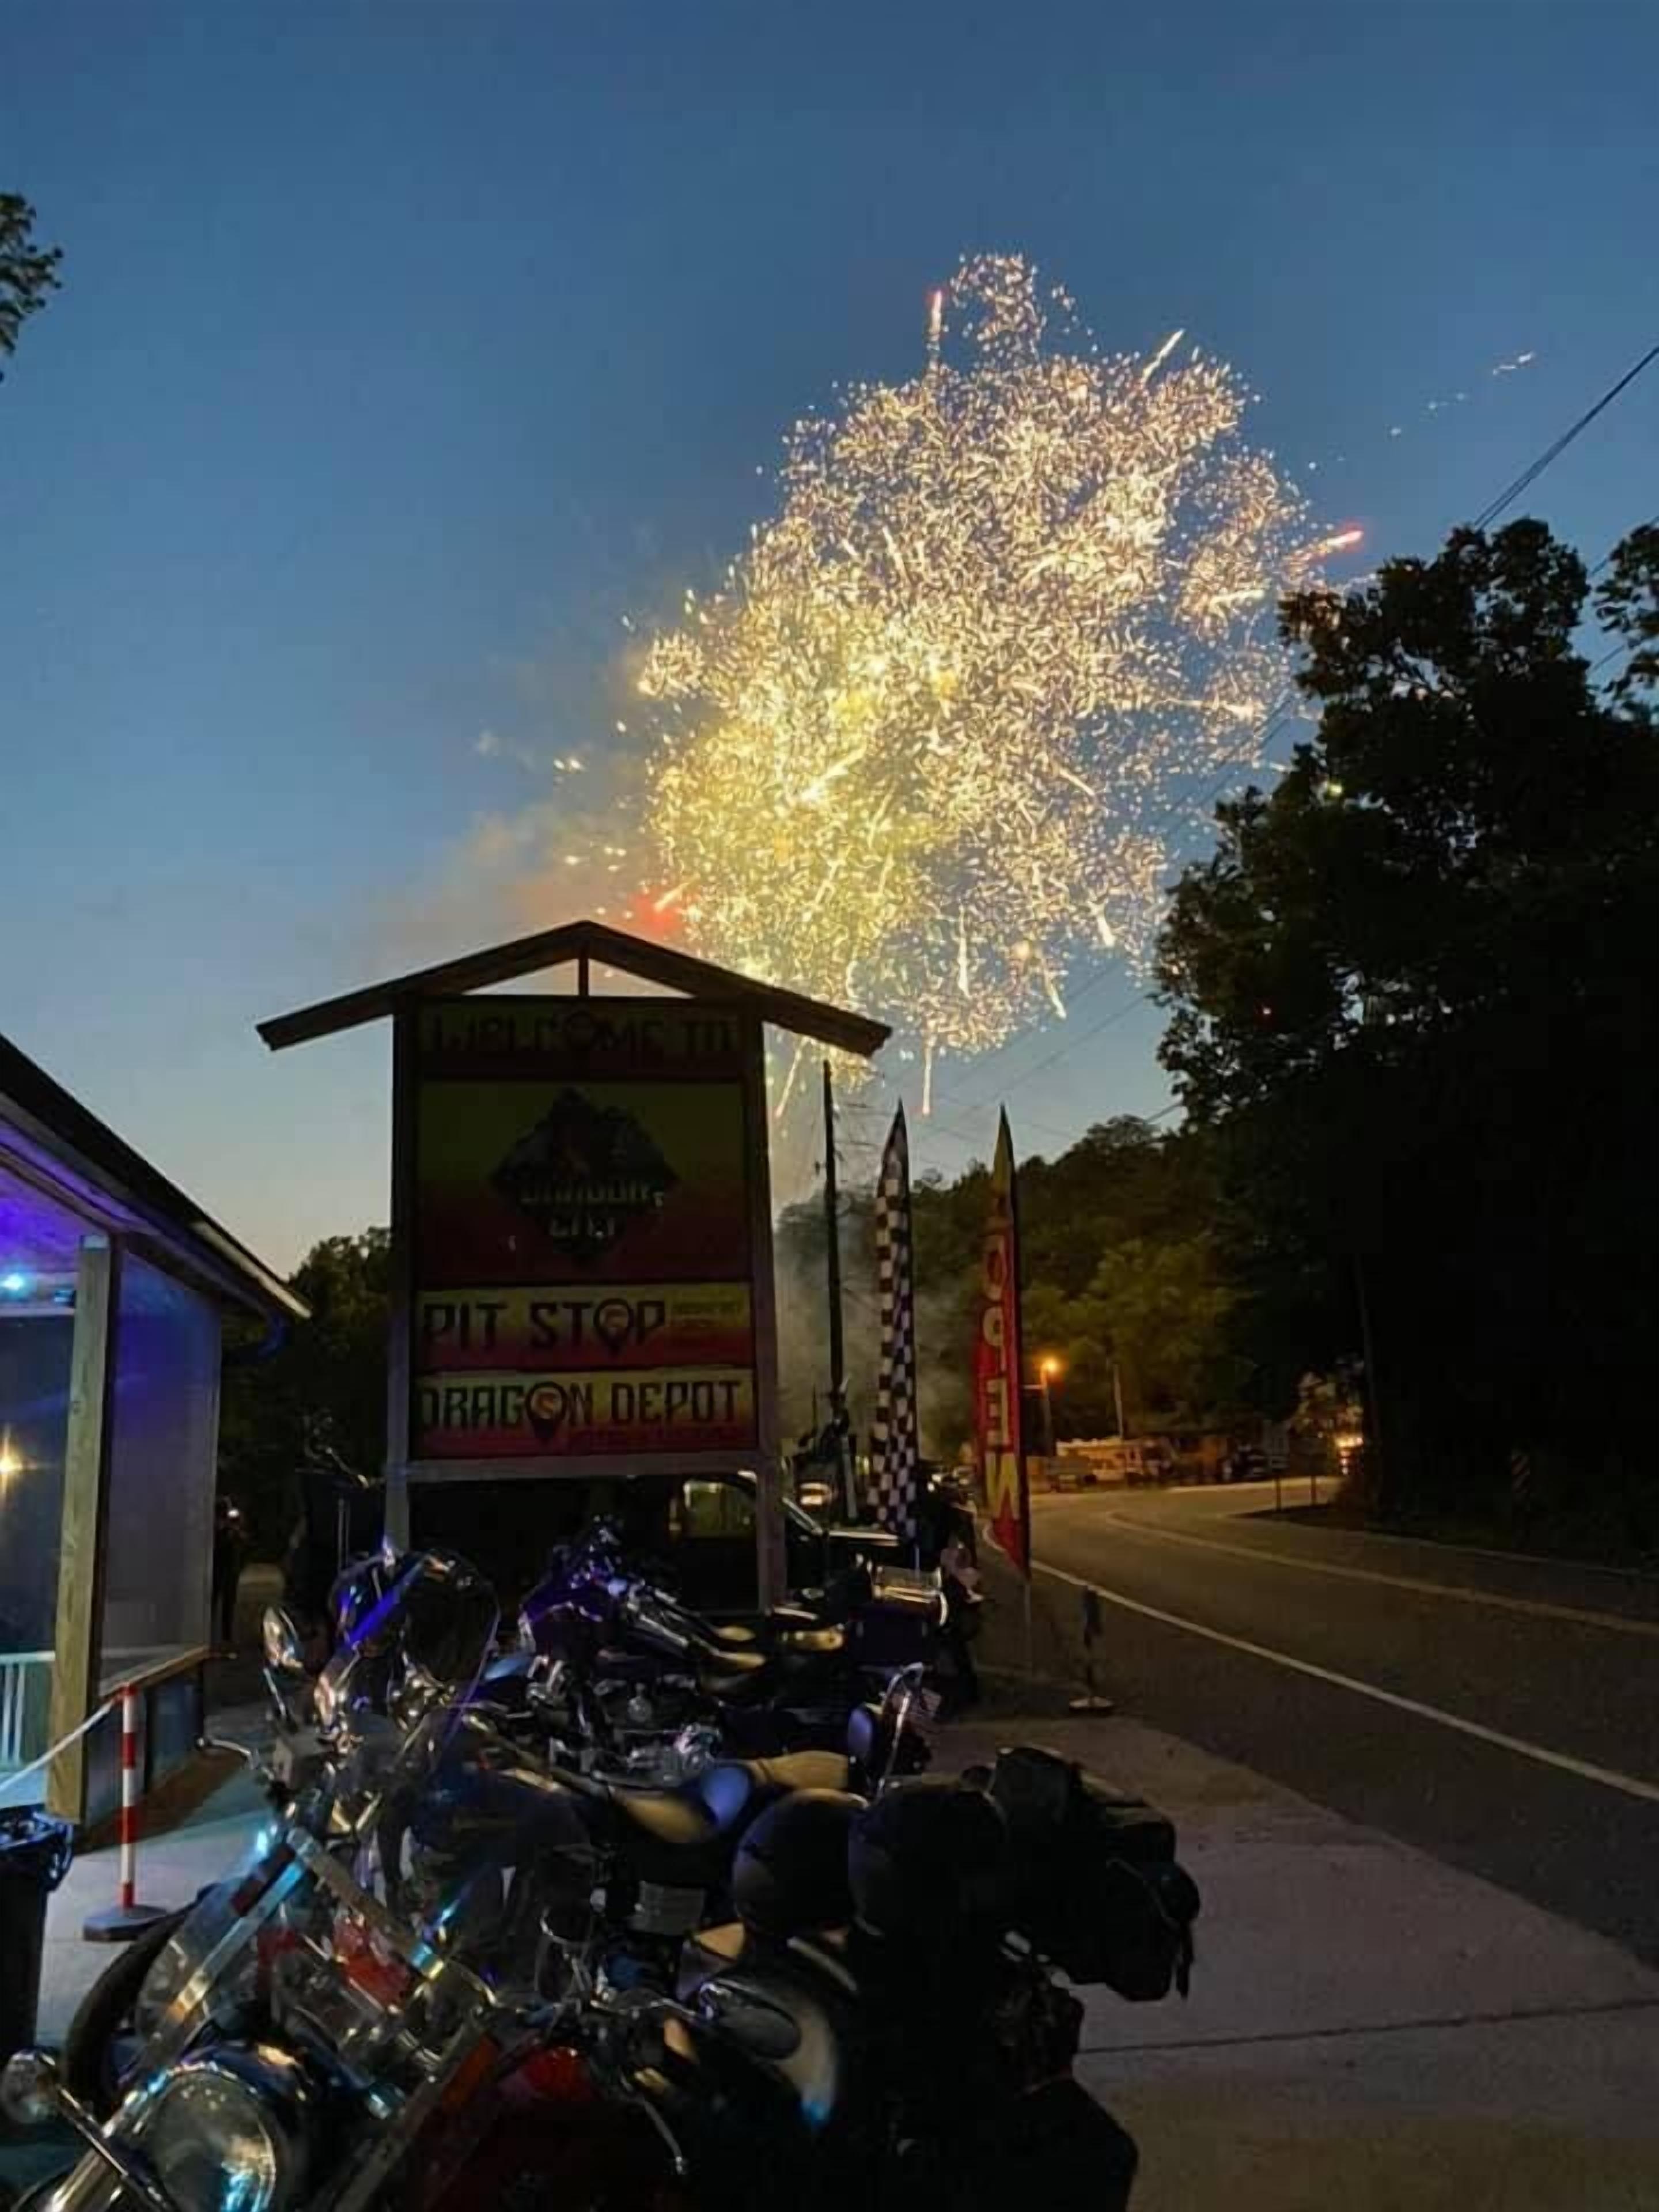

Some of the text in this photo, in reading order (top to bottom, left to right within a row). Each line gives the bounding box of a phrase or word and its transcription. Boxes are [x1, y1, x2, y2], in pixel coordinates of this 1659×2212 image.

[435, 1012, 664, 1062] WELCOME
[423, 1302, 505, 1349] PIT
[530, 1298, 665, 1354] STOP
[420, 1380, 741, 1441] DRAGON DEPOT
